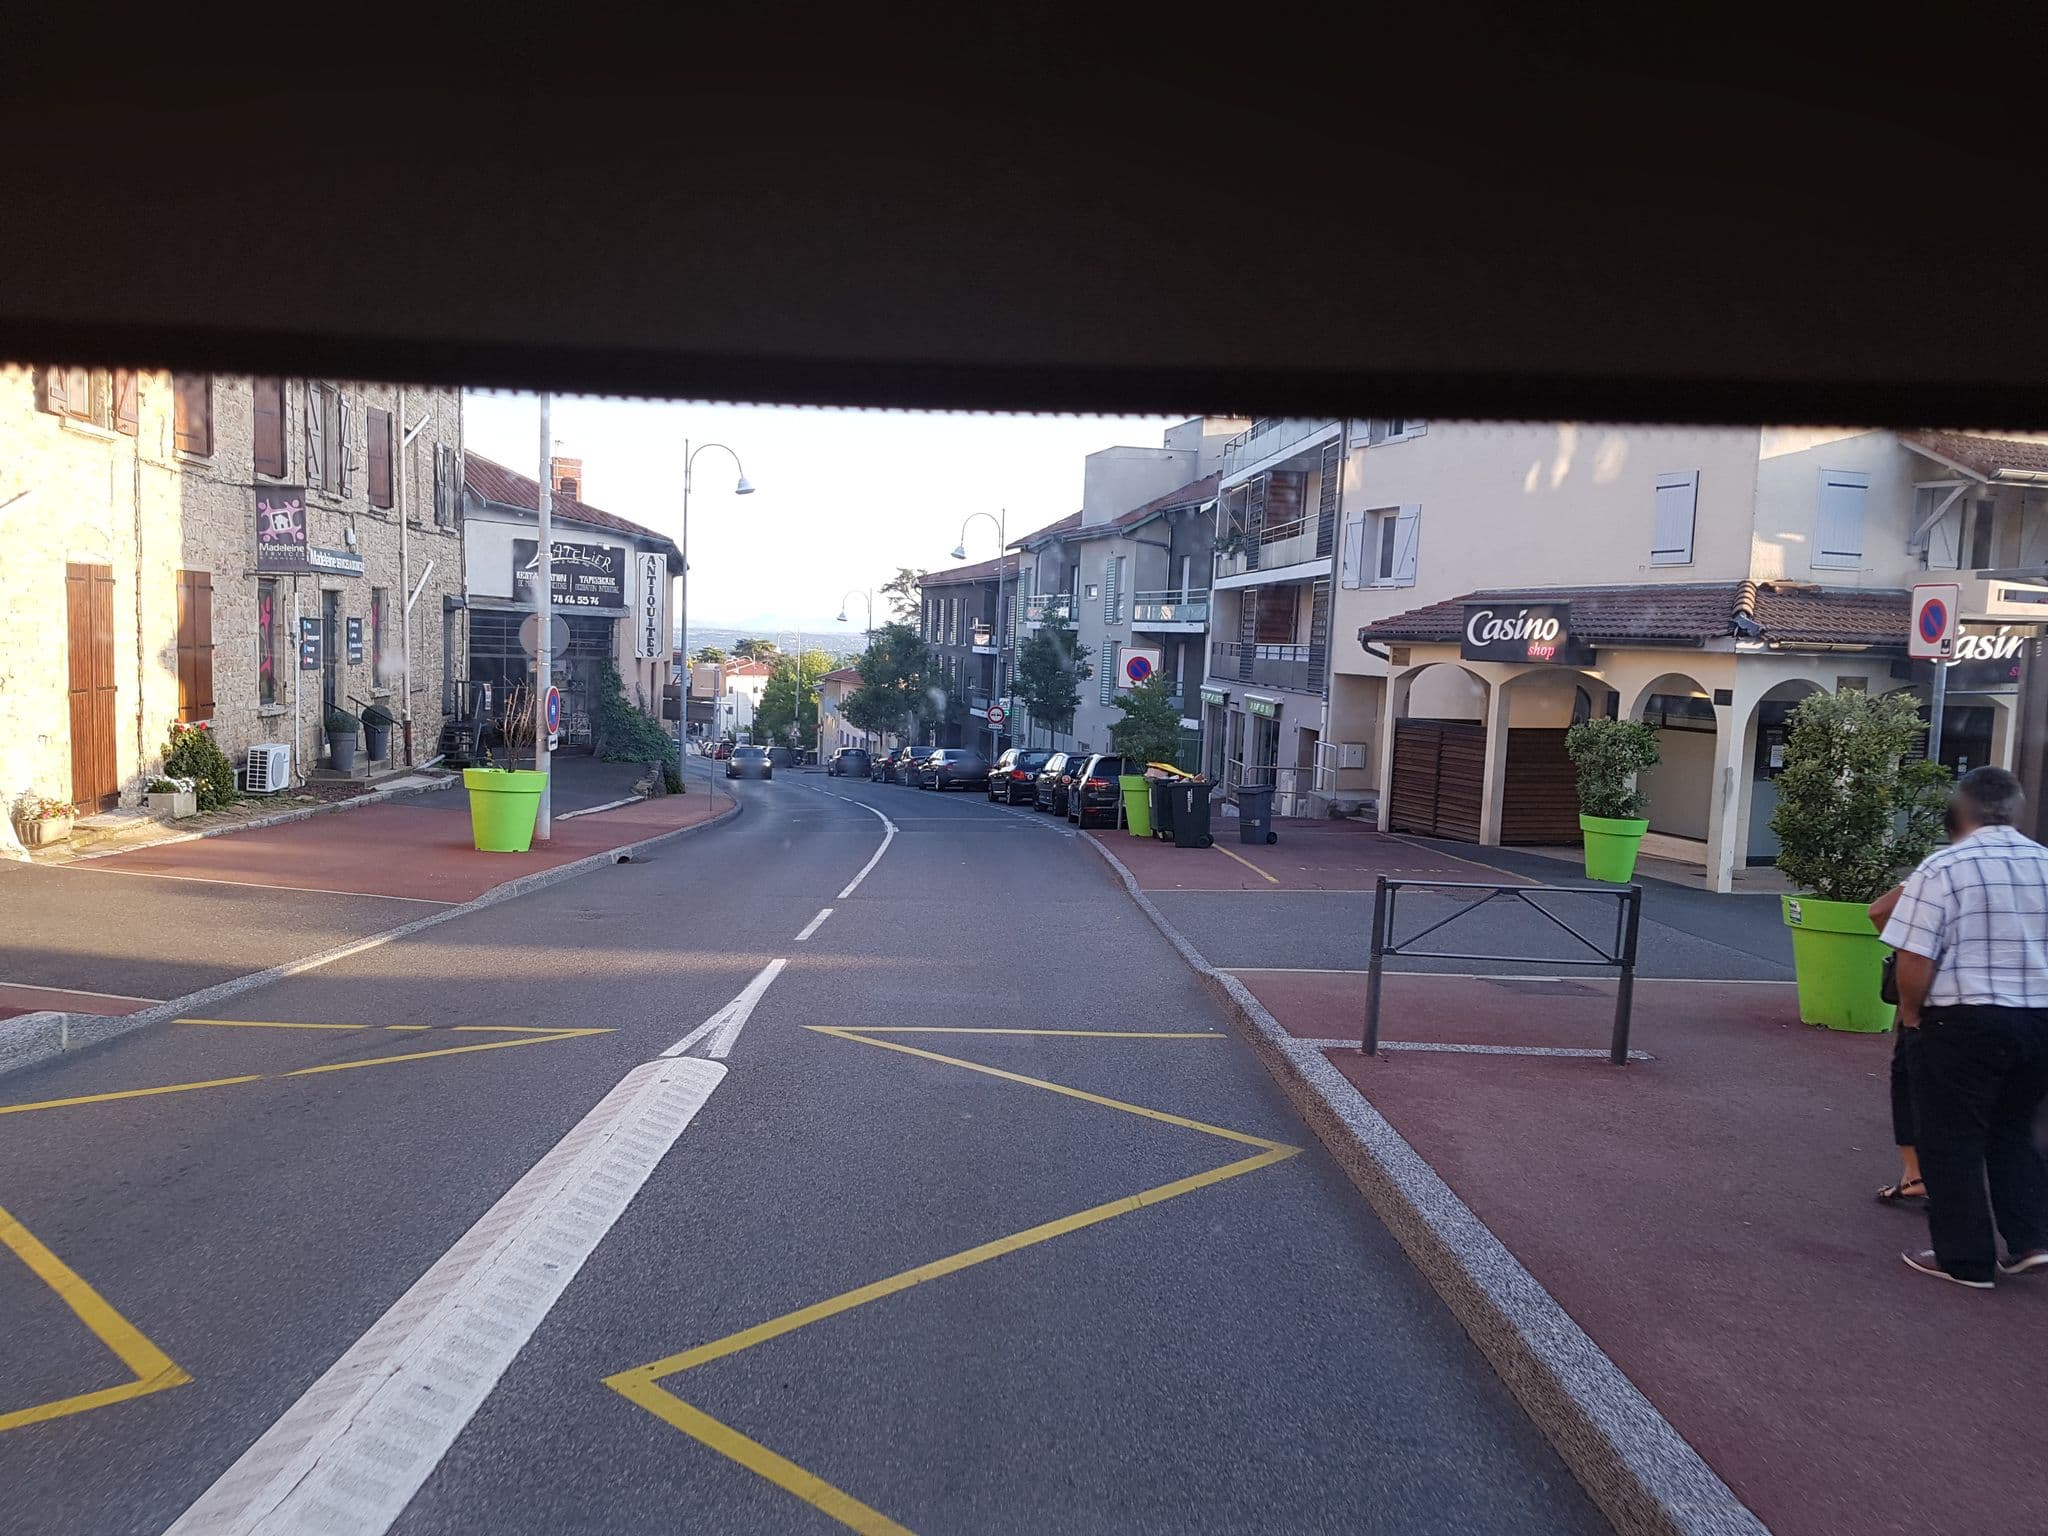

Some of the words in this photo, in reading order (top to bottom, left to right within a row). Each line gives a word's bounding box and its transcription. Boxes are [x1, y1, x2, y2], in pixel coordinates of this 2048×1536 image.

[259, 542, 305, 552] Madeleine
[552, 594, 563, 603] 78
[645, 555, 657, 657] ANTIQUITES
[1467, 609, 1560, 647] Casino
[1527, 642, 1555, 660] shop
